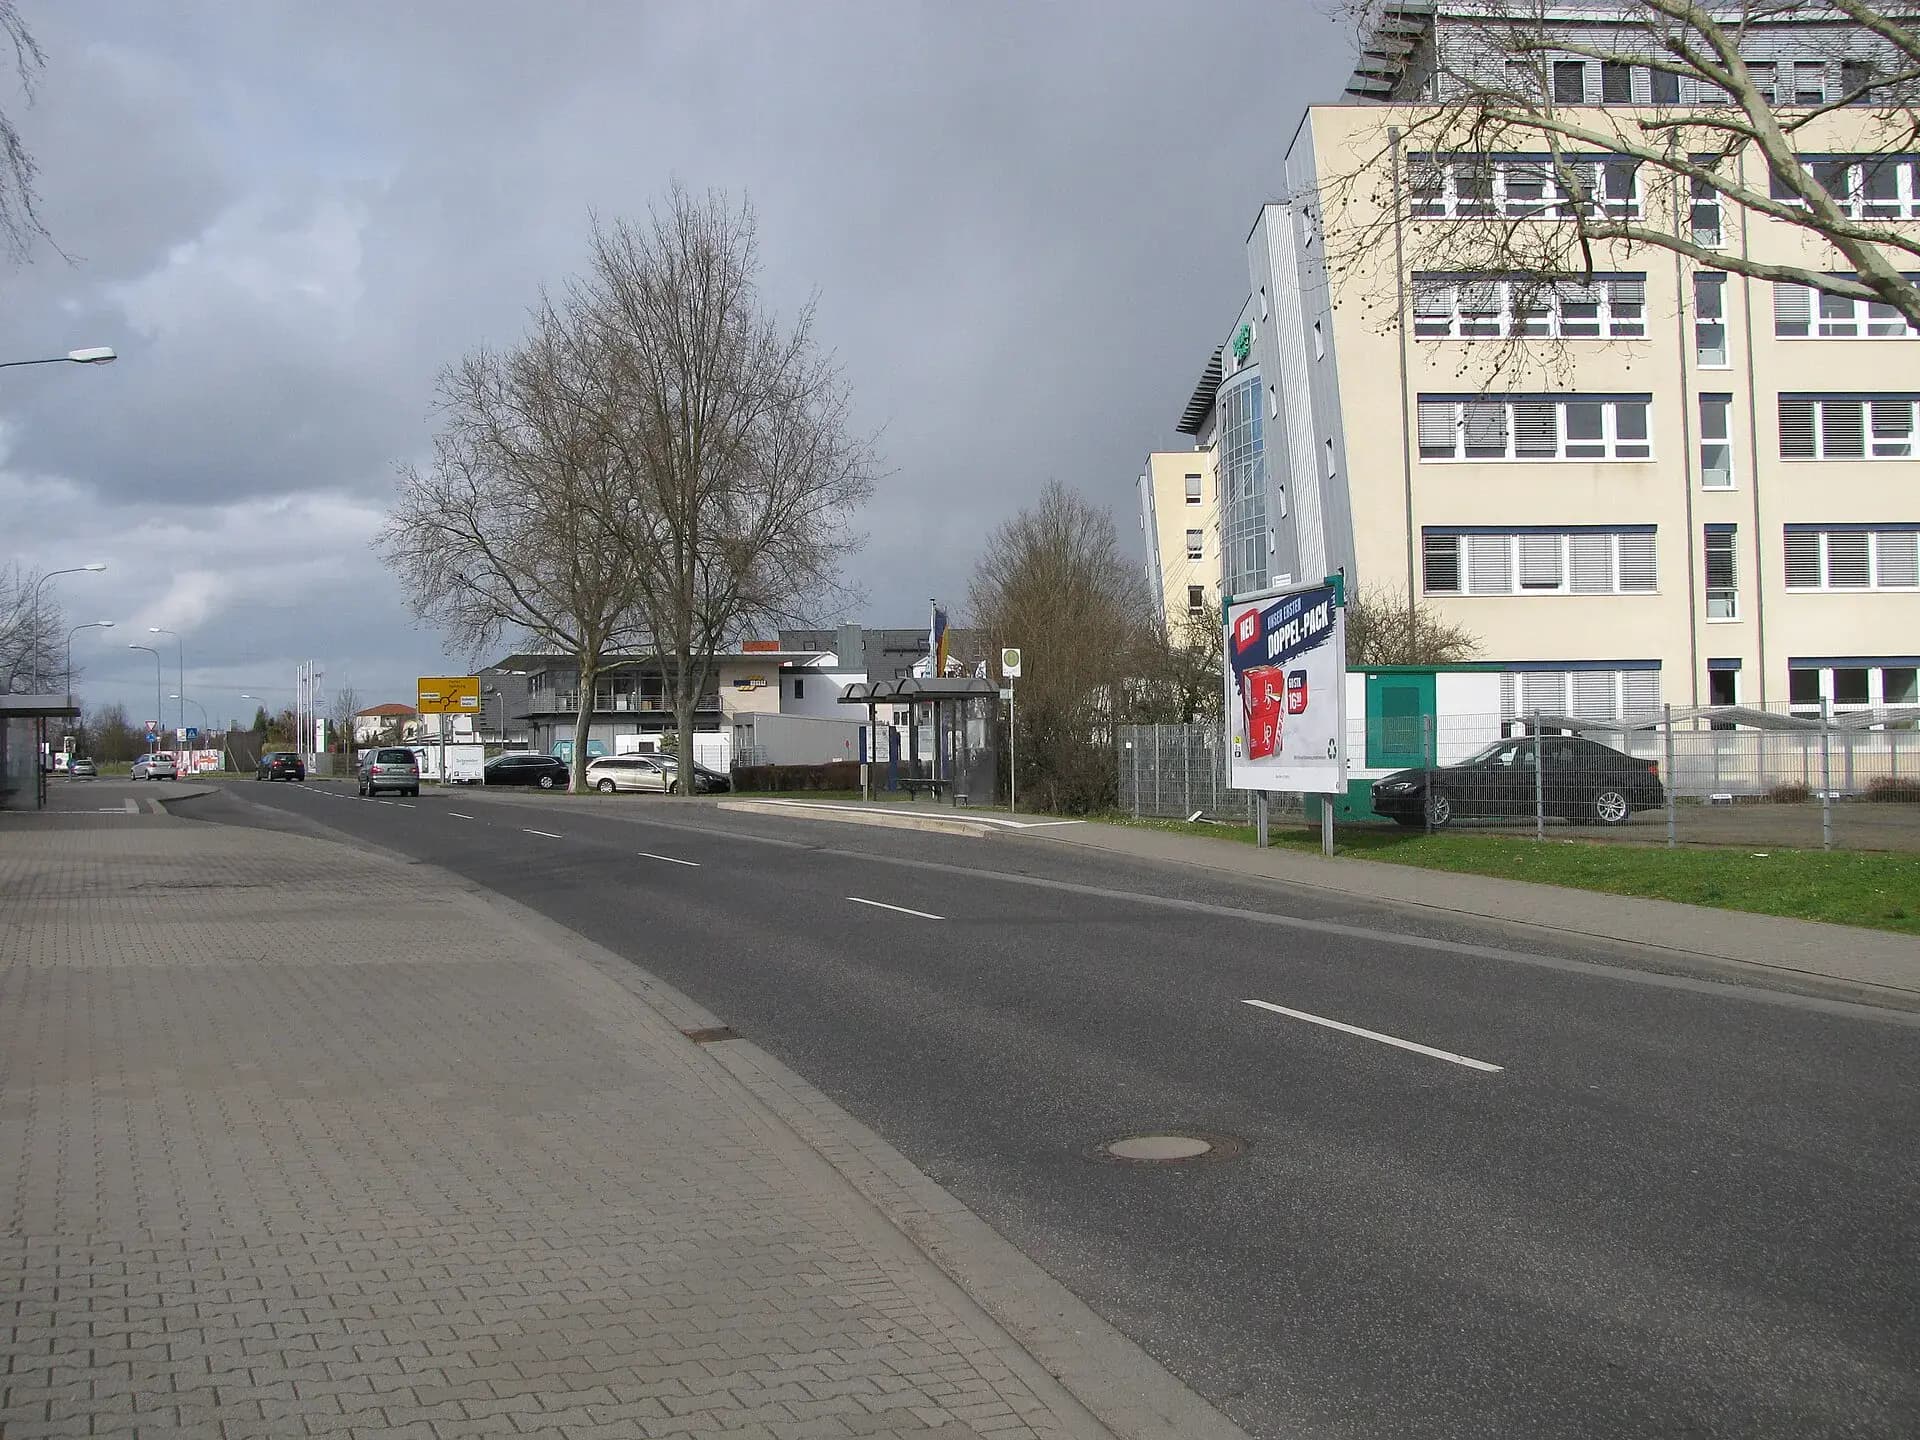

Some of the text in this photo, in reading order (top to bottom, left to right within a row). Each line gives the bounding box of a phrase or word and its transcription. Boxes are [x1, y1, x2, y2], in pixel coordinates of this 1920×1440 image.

[1240, 615, 1254, 642] NEU
[1267, 597, 1302, 630] UNSER ERSTER
[1268, 600, 1329, 659] DOPPEL-PACK
